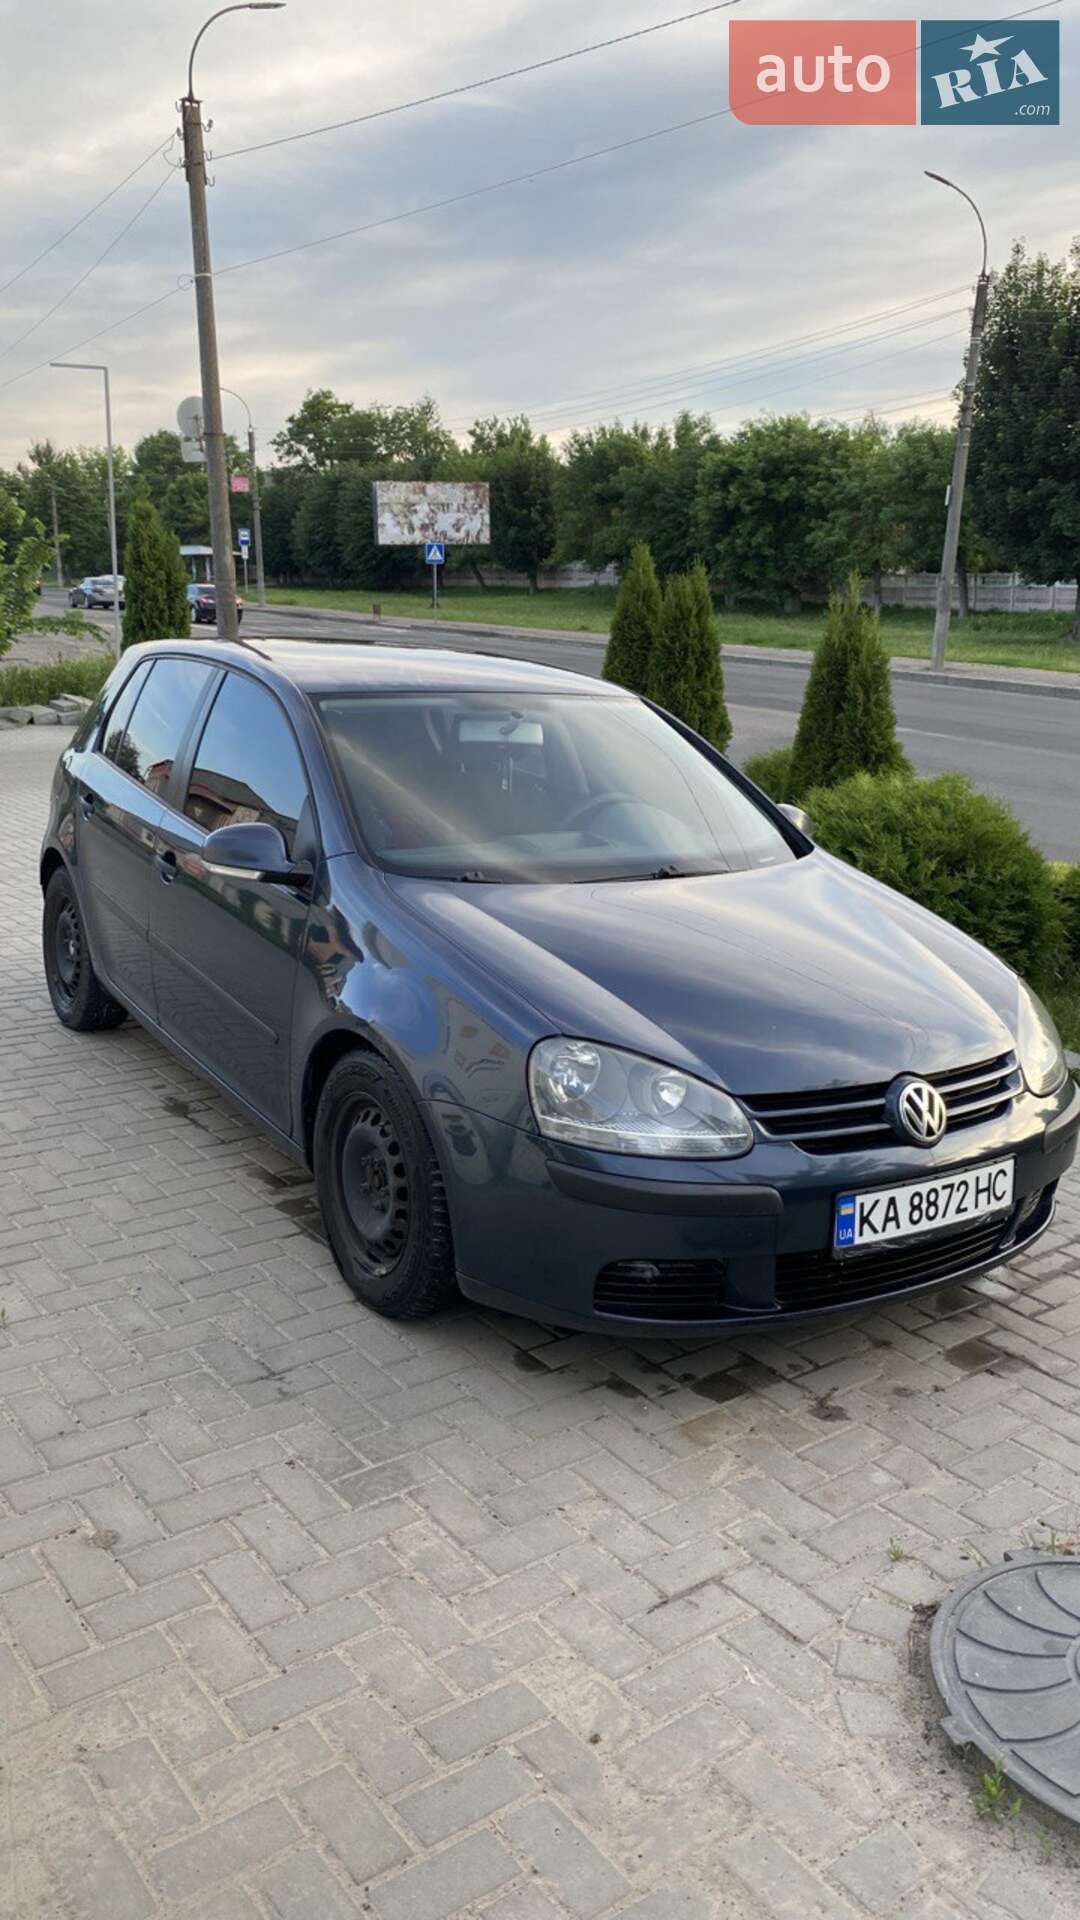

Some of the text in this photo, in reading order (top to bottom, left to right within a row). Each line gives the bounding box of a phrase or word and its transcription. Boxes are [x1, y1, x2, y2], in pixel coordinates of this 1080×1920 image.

[858, 1168, 1008, 1237] KA 8872 HC
[839, 1228, 853, 1240] UA
